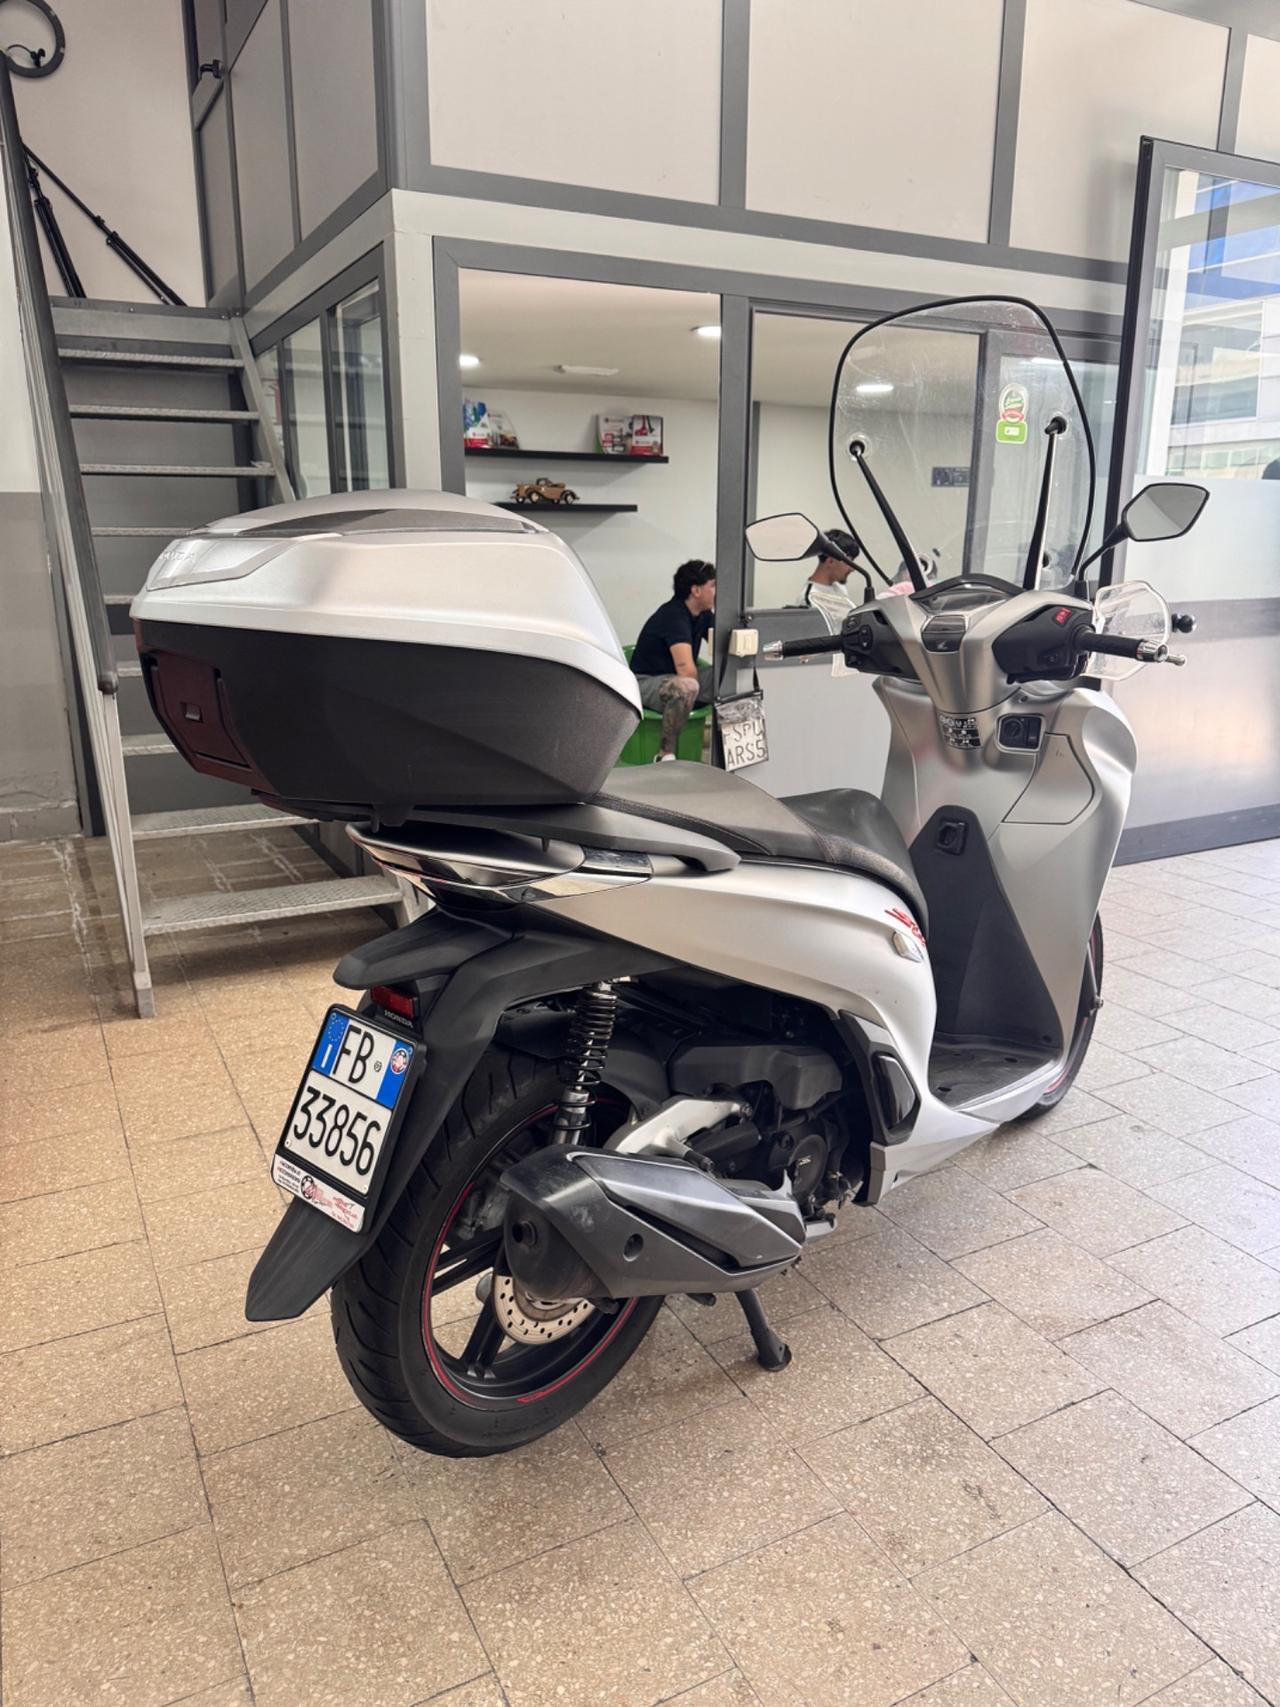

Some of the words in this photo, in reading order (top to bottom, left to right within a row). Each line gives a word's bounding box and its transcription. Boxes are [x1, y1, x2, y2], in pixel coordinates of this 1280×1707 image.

[384, 1009, 414, 1028] HONDA
[333, 1024, 375, 1084] FB
[293, 1085, 381, 1176] 33856
